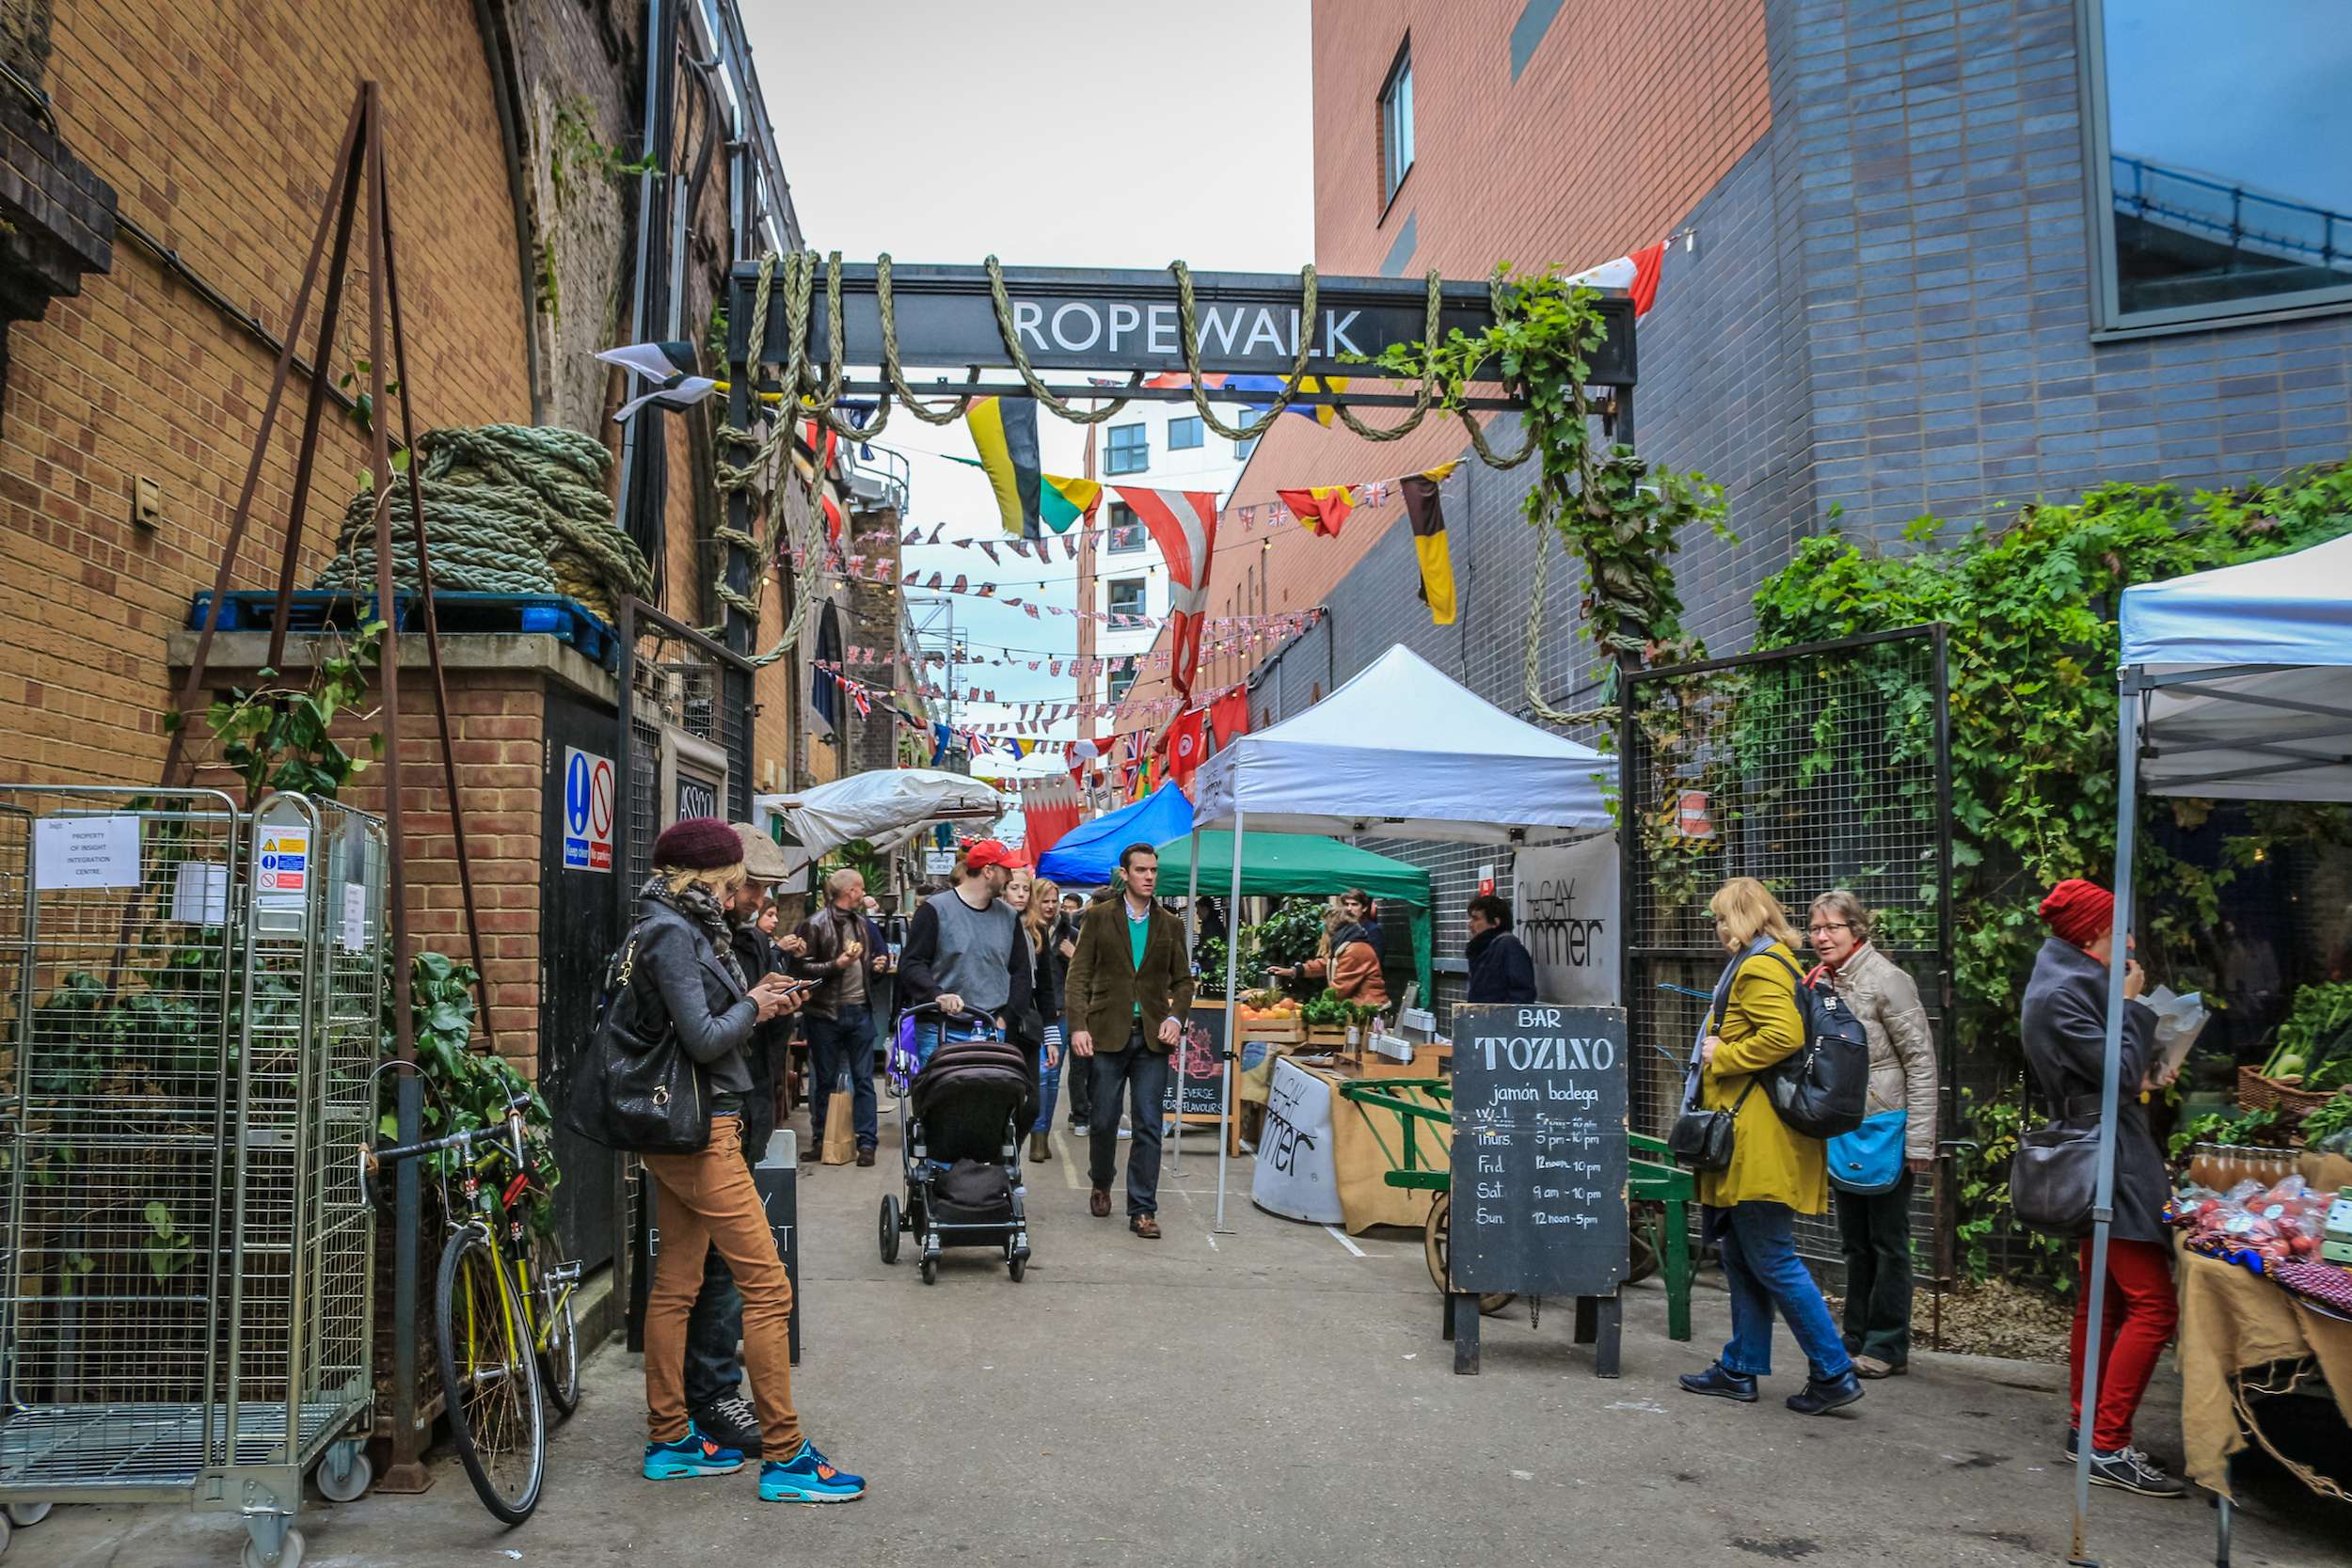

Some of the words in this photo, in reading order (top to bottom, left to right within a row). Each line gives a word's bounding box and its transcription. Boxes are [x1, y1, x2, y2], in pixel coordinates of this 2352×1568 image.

[1012, 301, 1362, 358] ROPEWALK
[1518, 1008, 1562, 1029] BAR
[1474, 1037, 1615, 1071] TOZINO
[1548, 1080, 1599, 1111] bodega
